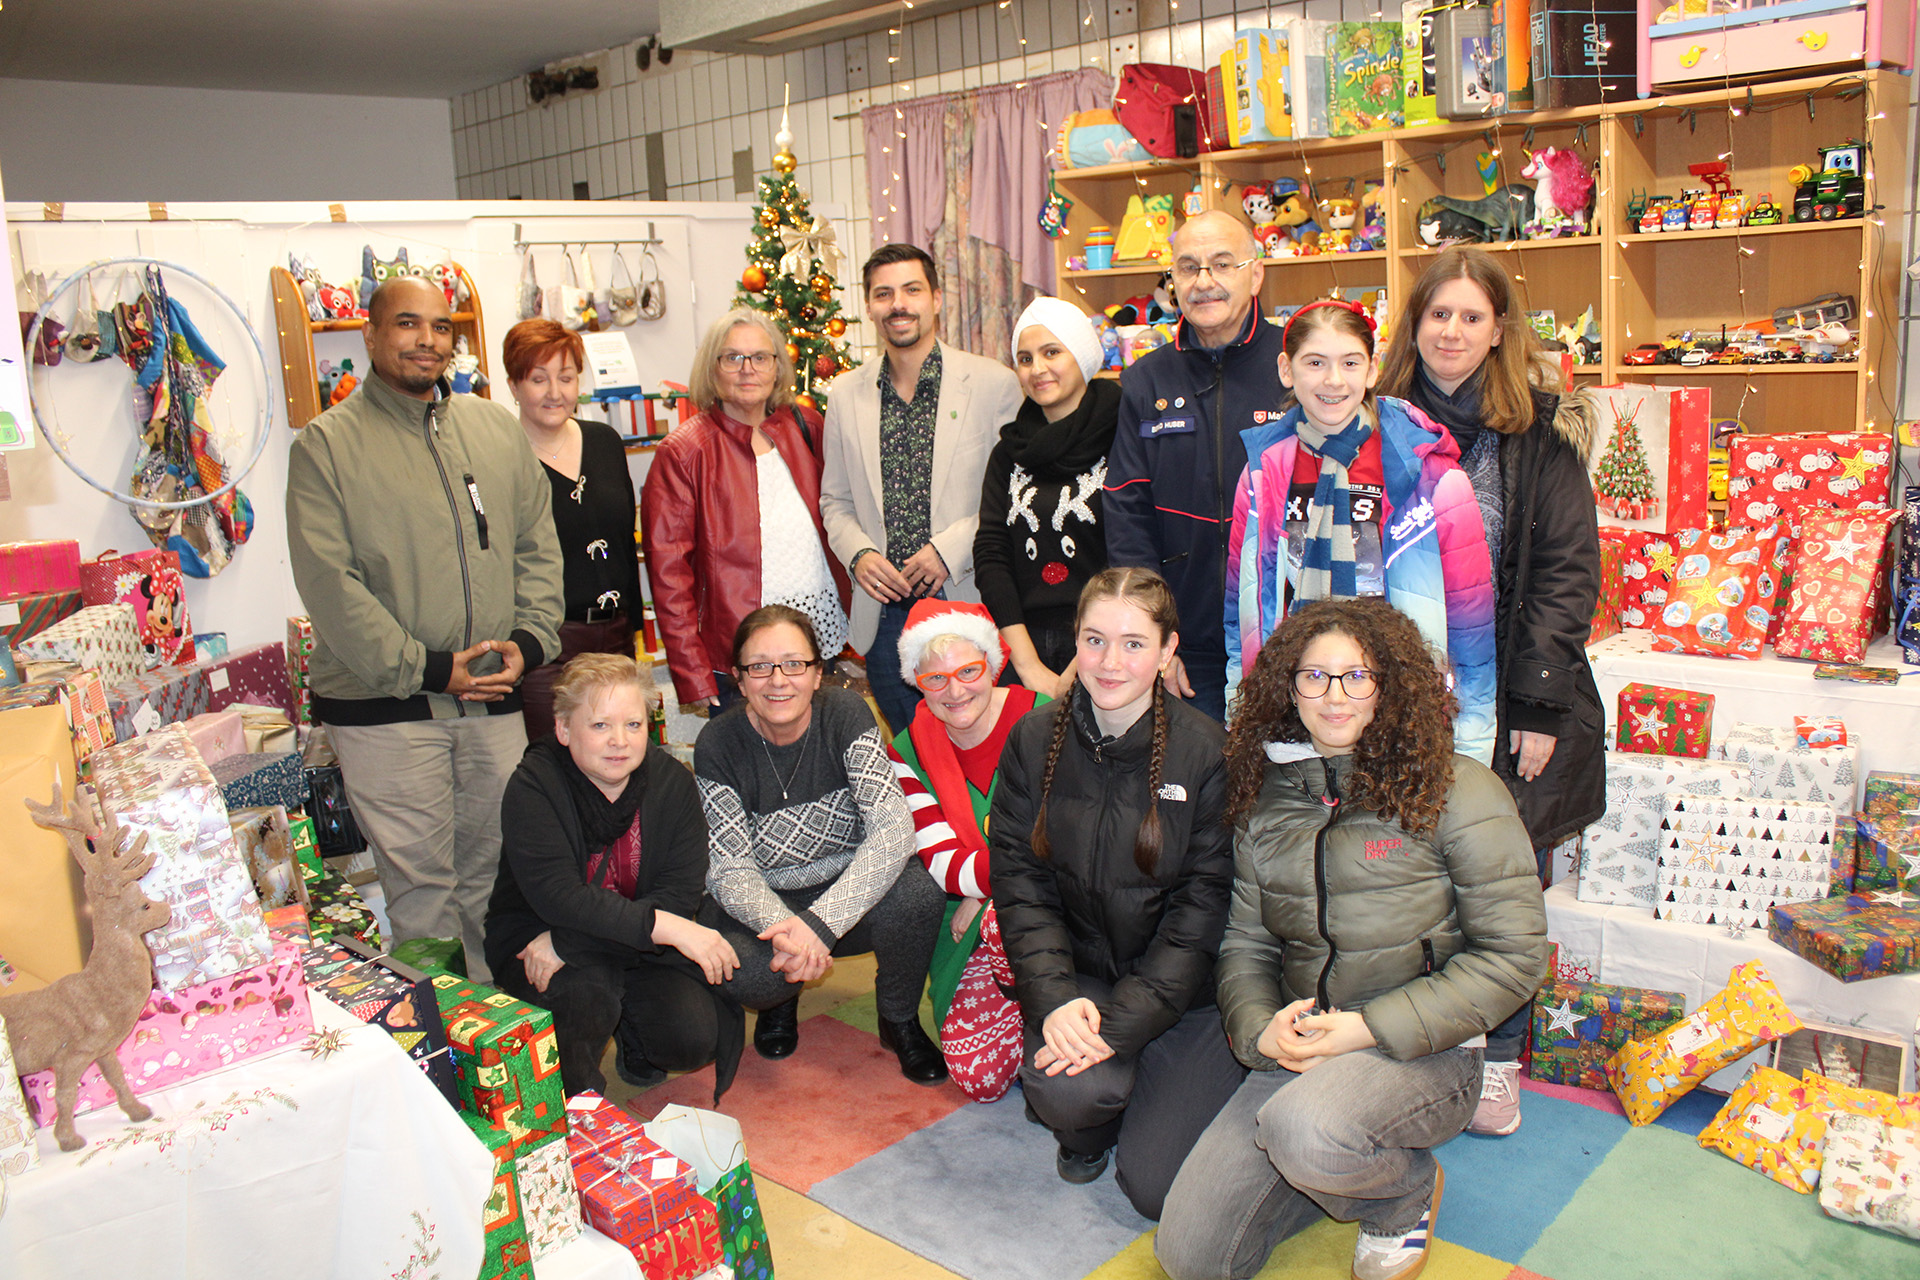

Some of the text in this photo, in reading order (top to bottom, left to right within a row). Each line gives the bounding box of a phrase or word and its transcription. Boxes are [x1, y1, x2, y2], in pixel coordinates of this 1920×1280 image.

[1583, 23, 1608, 66] HEAD
[1599, 23, 1607, 53] QARTER
[1344, 53, 1404, 88] Spinde
[1190, 196, 1201, 212] A
[1645, 721, 1656, 730] 58
[1365, 838, 1403, 850] SUPER
[1700, 845, 1711, 855] 63
